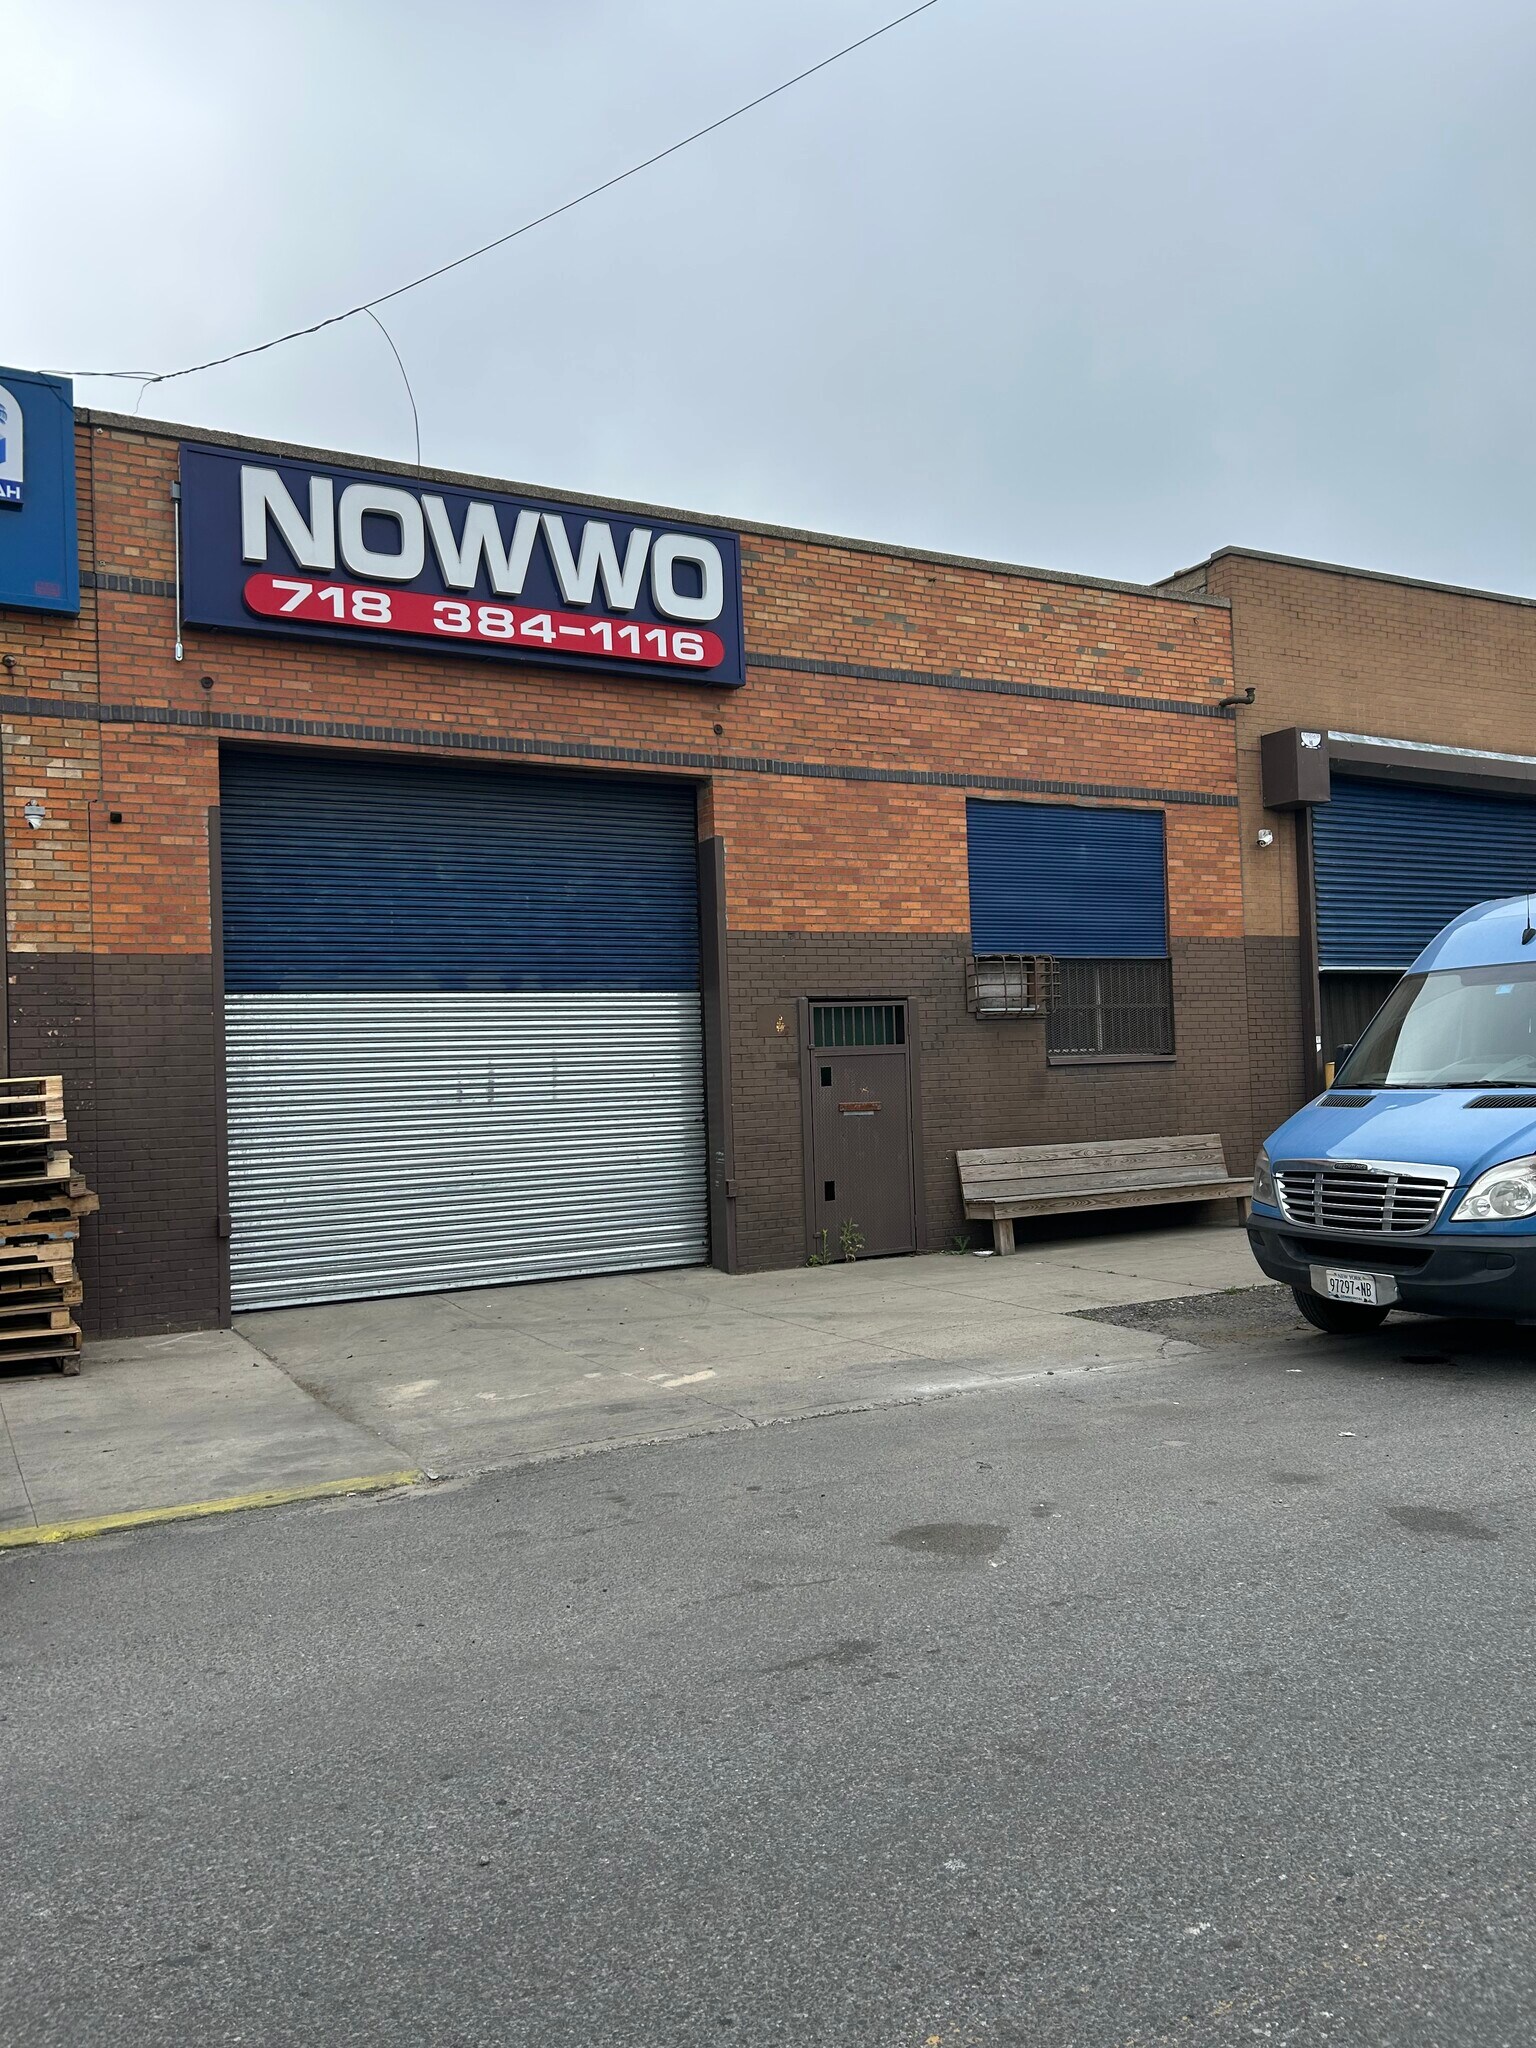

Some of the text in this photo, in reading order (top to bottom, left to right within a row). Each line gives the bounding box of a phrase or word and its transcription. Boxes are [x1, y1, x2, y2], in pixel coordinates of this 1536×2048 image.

[240, 464, 724, 622] NOWWO
[271, 578, 705, 662] 718 384-1116
[1329, 1278, 1372, 1297] 97297 NB
